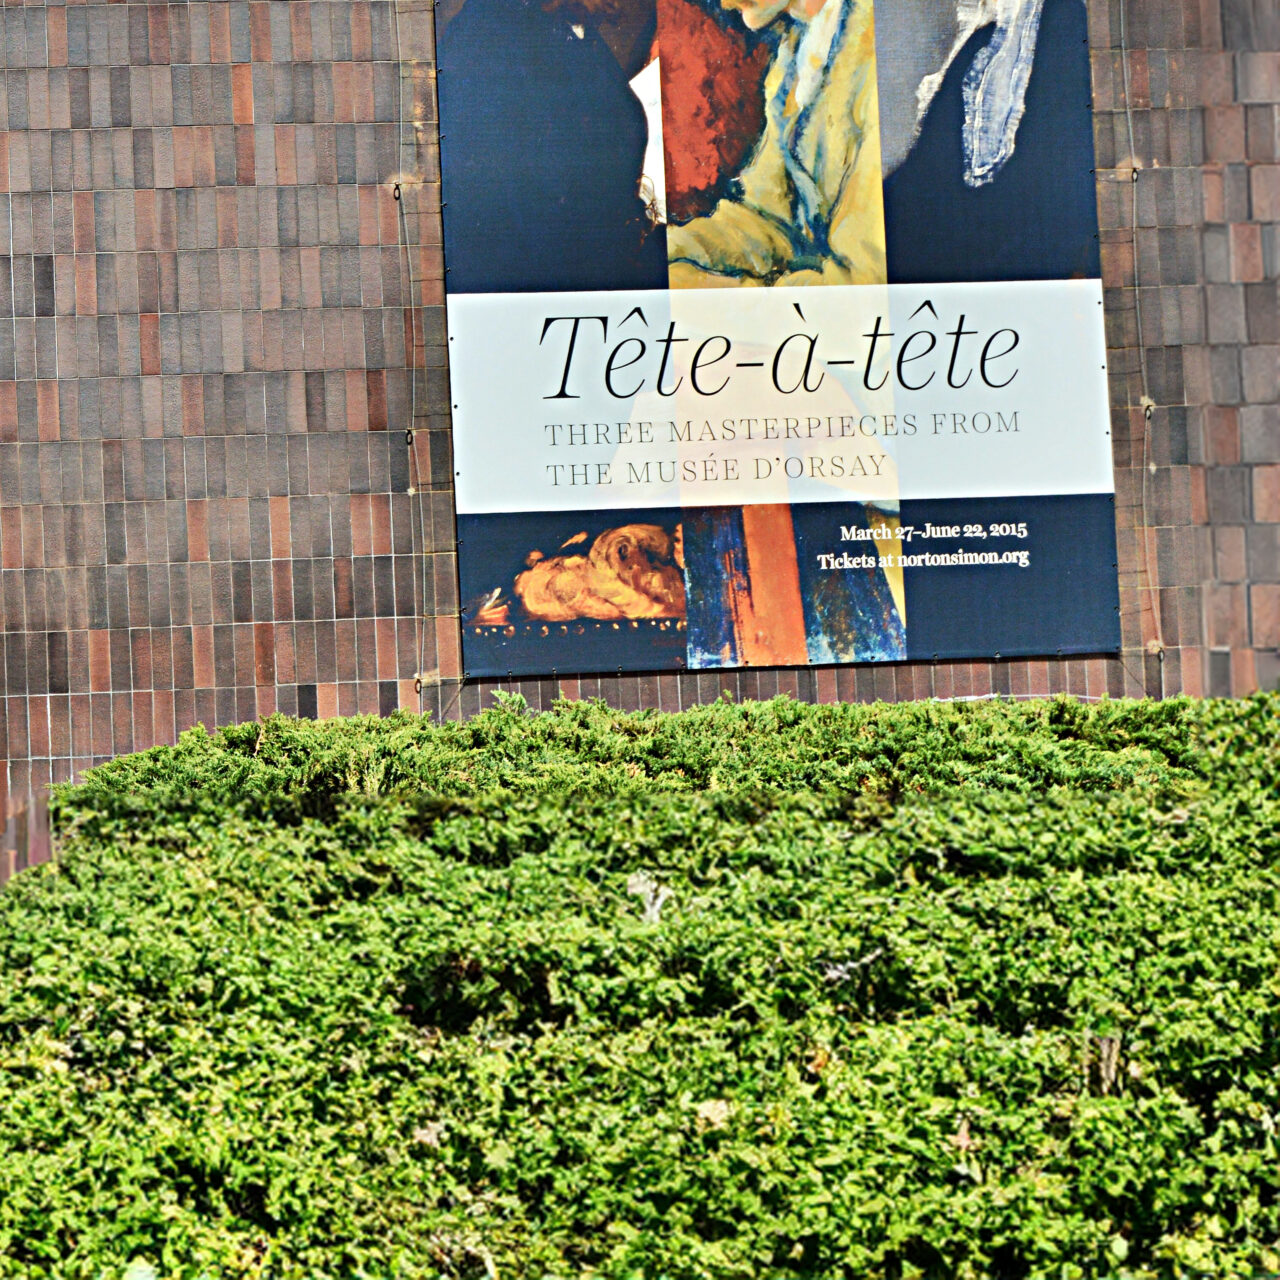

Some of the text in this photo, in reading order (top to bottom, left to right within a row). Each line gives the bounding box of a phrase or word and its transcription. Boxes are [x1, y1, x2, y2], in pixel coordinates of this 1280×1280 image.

[538, 299, 1021, 400] Tête-à-tête
[544, 410, 1021, 446] THREE MASTERPIECES FROM
[546, 463, 612, 486] THE
[627, 451, 740, 483] MUSÉE
[840, 523, 892, 542] March
[963, 524, 987, 540] 22,
[989, 522, 1028, 539] 2015
[817, 549, 1030, 570] Tickets at nortonsimon.org
